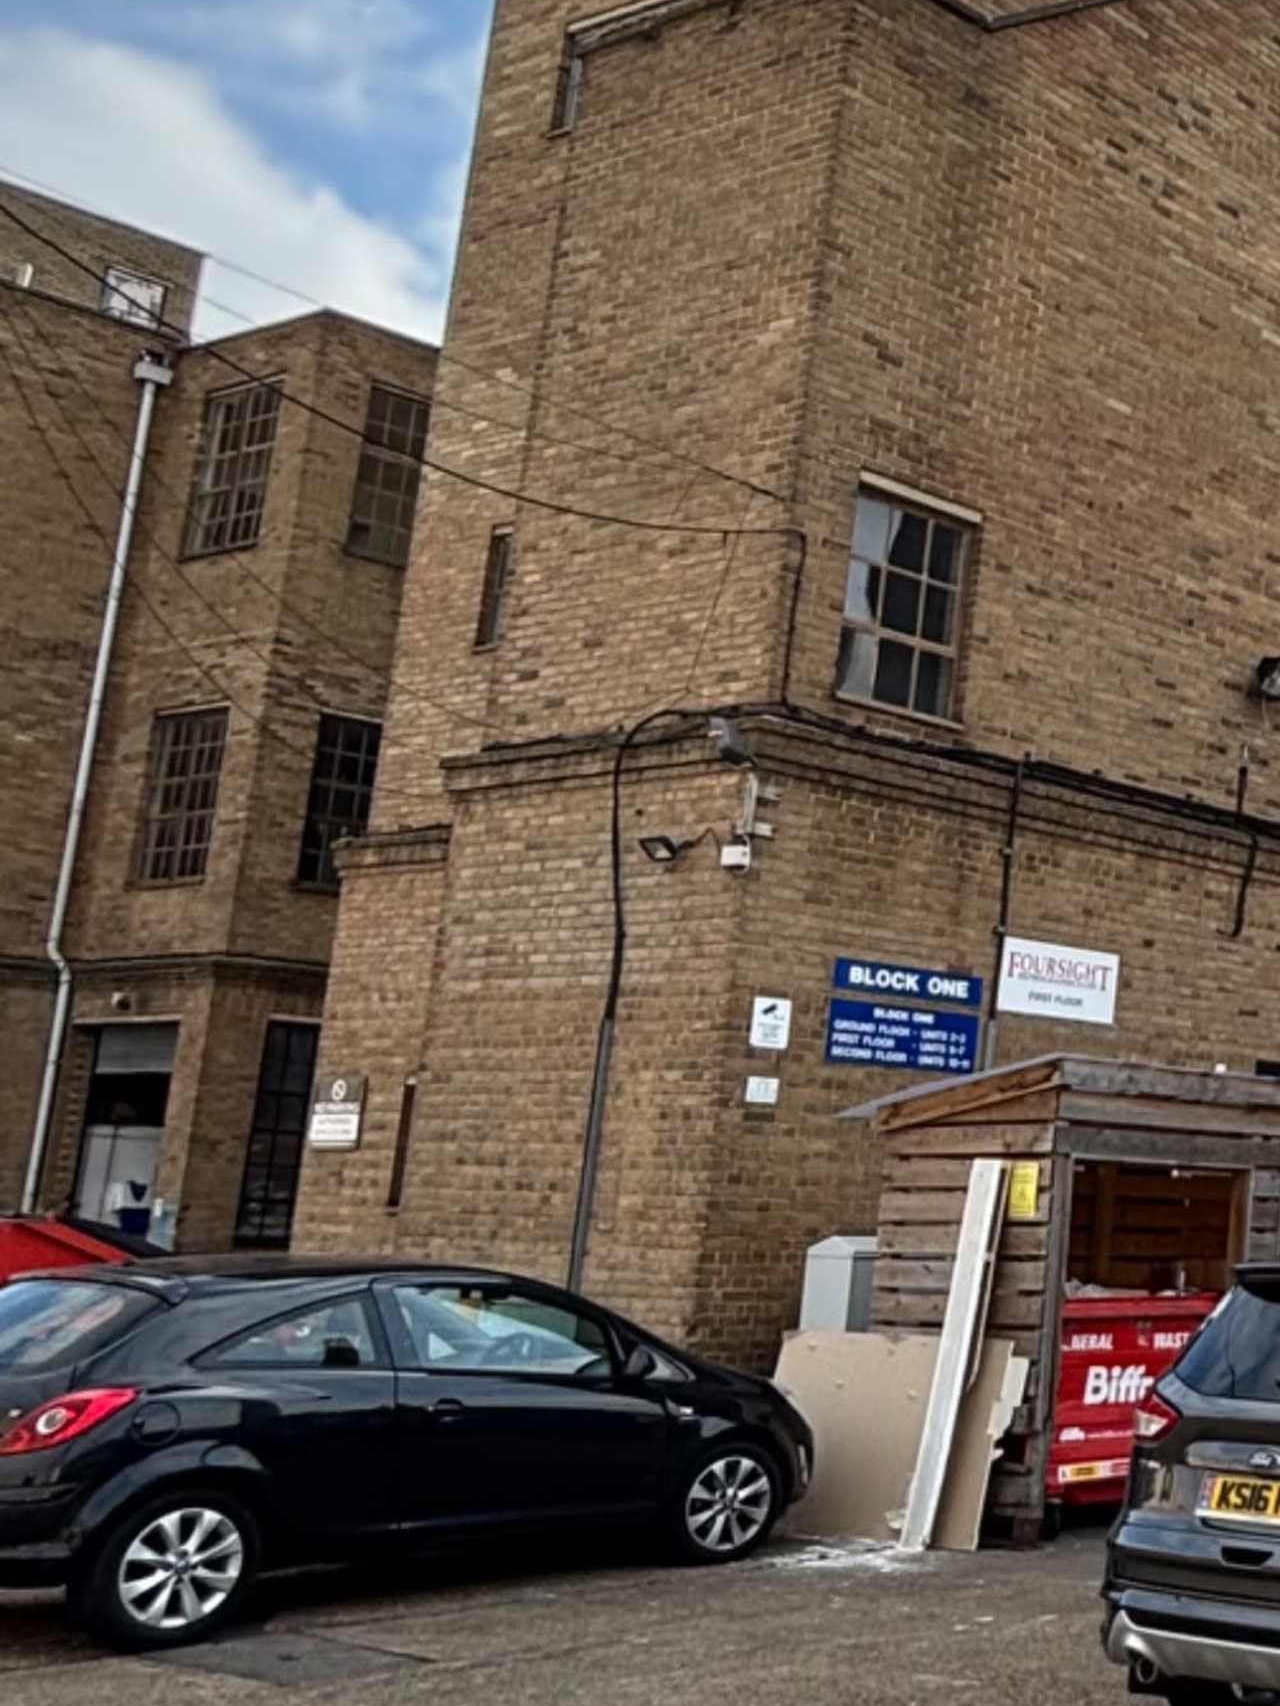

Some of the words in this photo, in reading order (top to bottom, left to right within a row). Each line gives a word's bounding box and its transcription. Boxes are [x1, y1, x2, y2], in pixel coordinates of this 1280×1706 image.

[849, 965, 920, 992] BLOCK
[928, 976, 969, 998] ONE
[1007, 951, 1113, 991] FOURSIGHT
[912, 1012, 935, 1025] ONE
[833, 1019, 876, 1033] GROUND
[878, 1024, 911, 1037] FLOOR
[920, 1029, 948, 1041] UNITS
[831, 1032, 860, 1044] FIRST
[862, 1035, 895, 1048] FLOOR
[919, 1042, 946, 1053] UNITS
[830, 1045, 872, 1059] SECOND
[875, 1050, 908, 1062] FLOOR
[917, 1055, 945, 1067] UNITS
[1215, 1479, 1272, 1513] KS16
